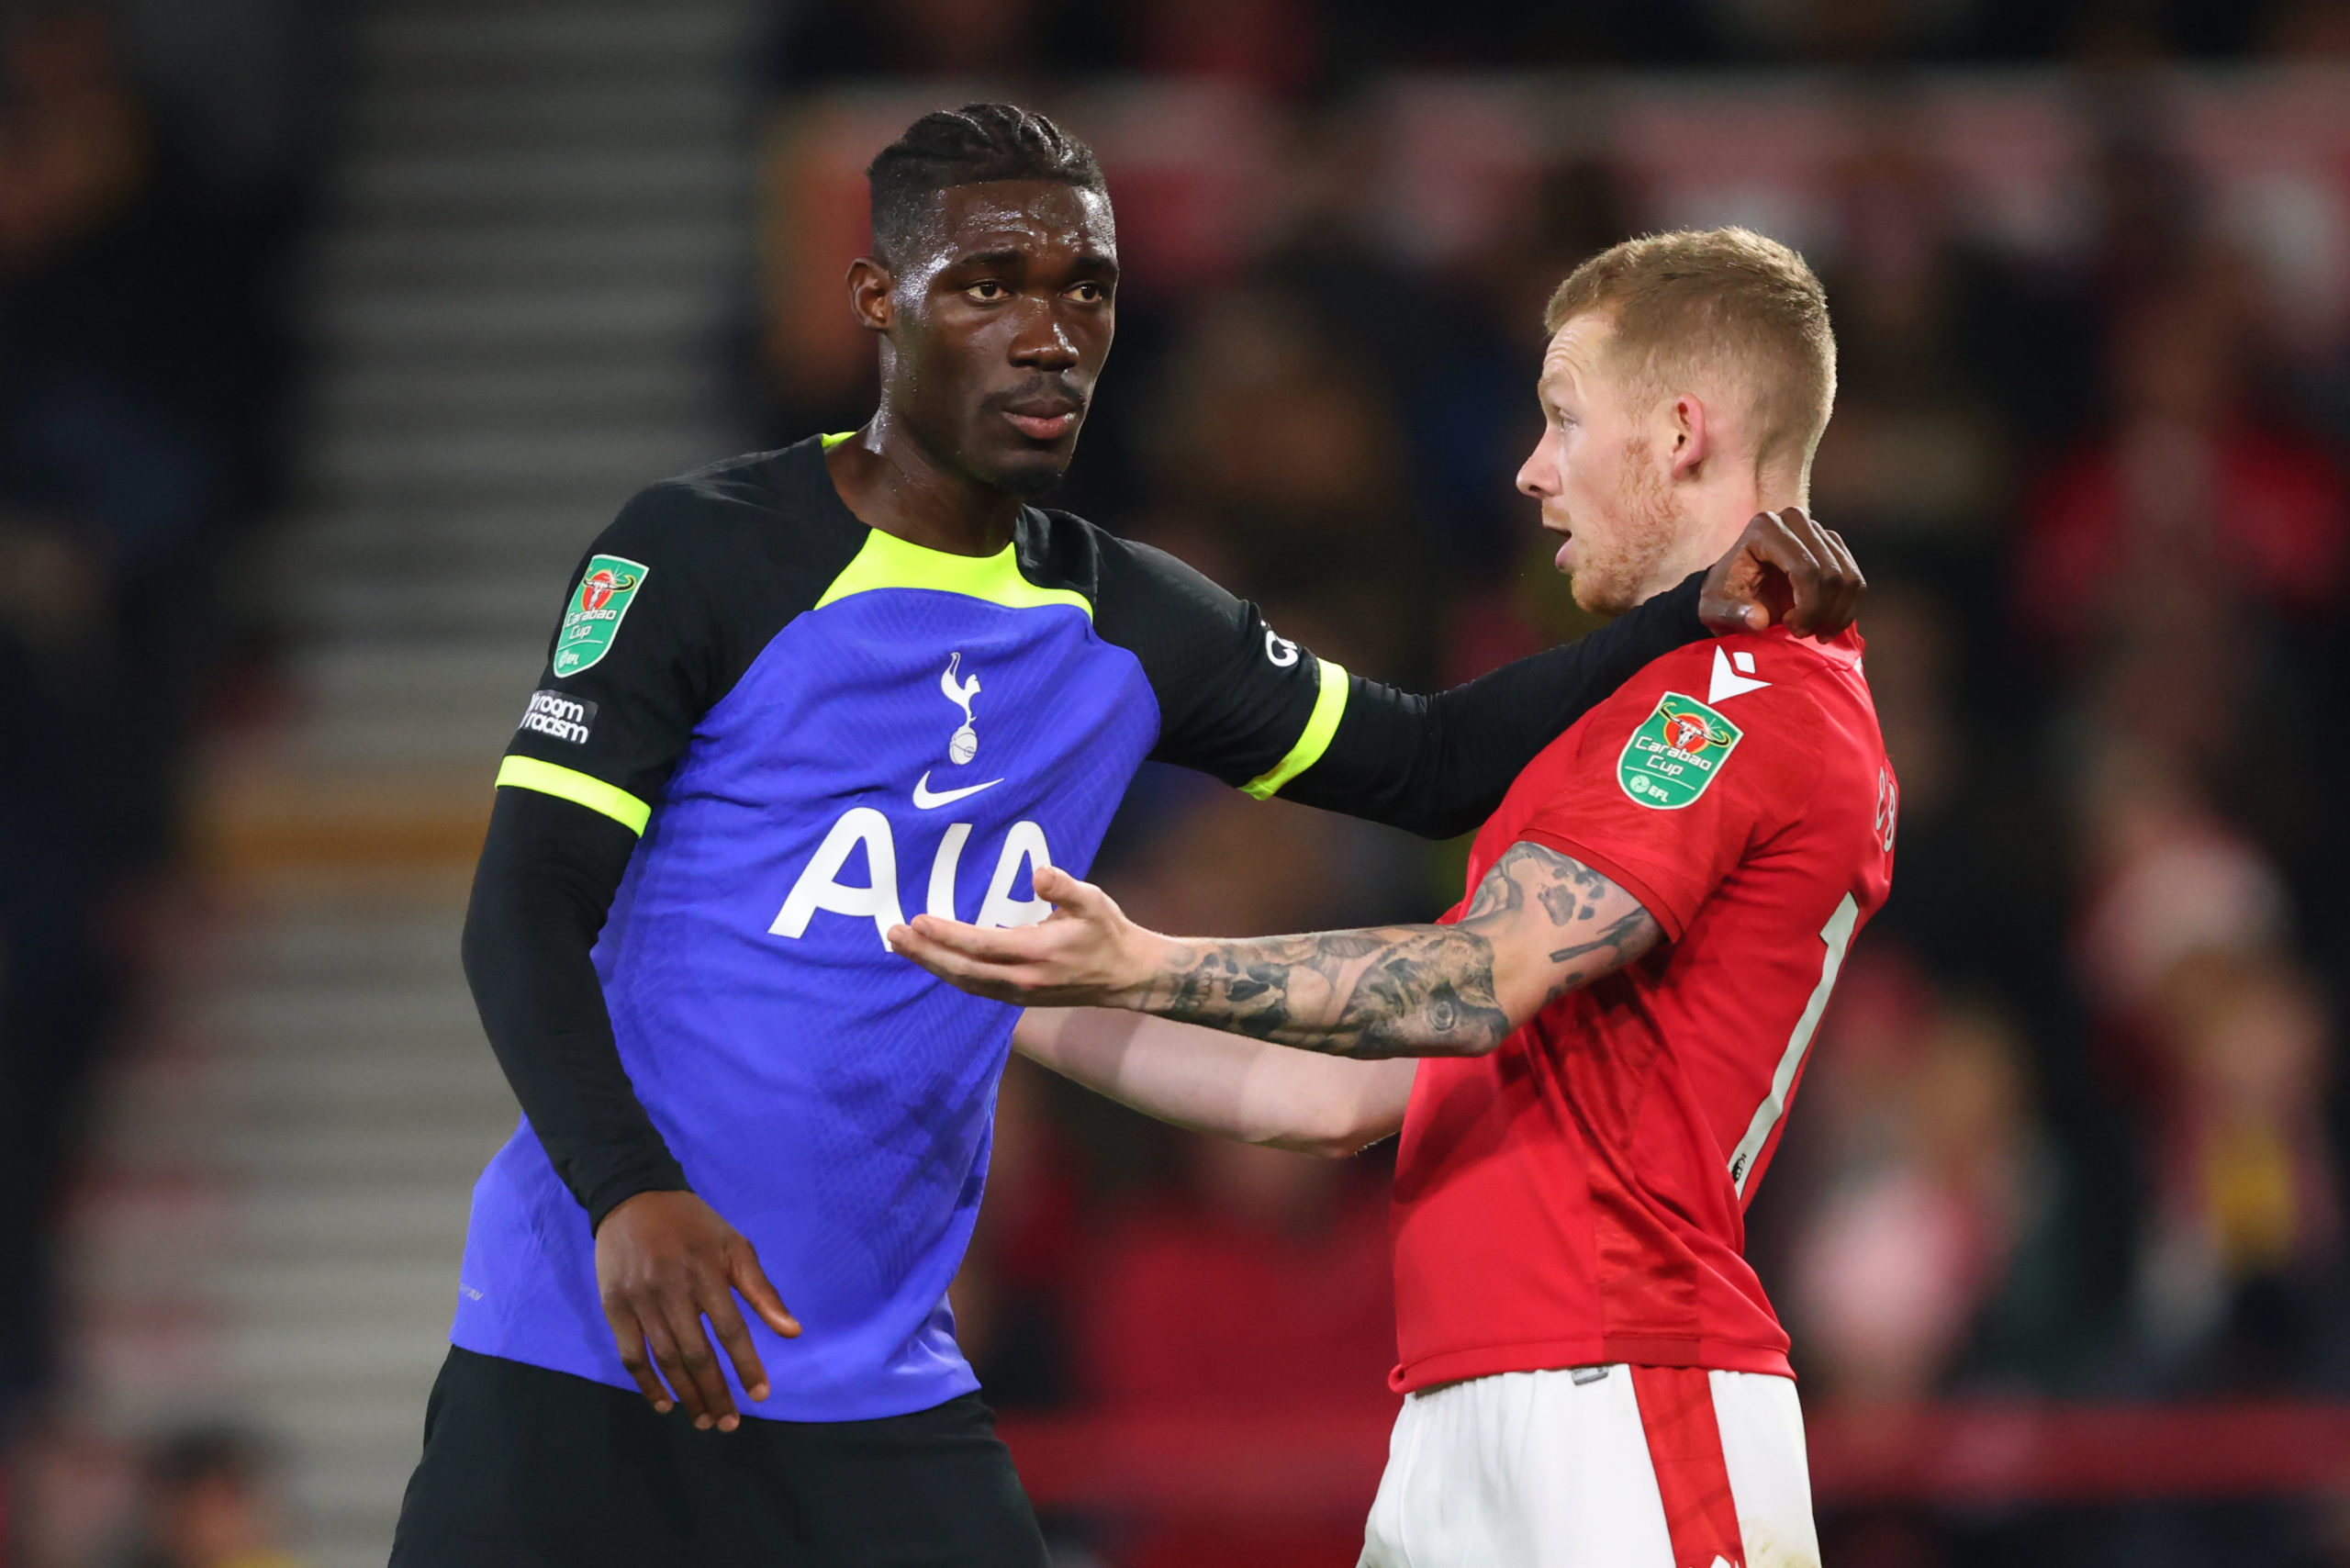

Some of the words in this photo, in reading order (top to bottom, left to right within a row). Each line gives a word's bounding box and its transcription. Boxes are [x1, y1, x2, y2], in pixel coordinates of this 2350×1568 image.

[566, 608, 617, 627] Carabao
[569, 624, 592, 639] Cup
[534, 696, 584, 722] room
[524, 712, 588, 744] racism
[1635, 736, 1712, 771] Carabao
[1646, 755, 1684, 777] Cup
[1648, 785, 1669, 802] EFL
[767, 807, 1055, 953] AIA
